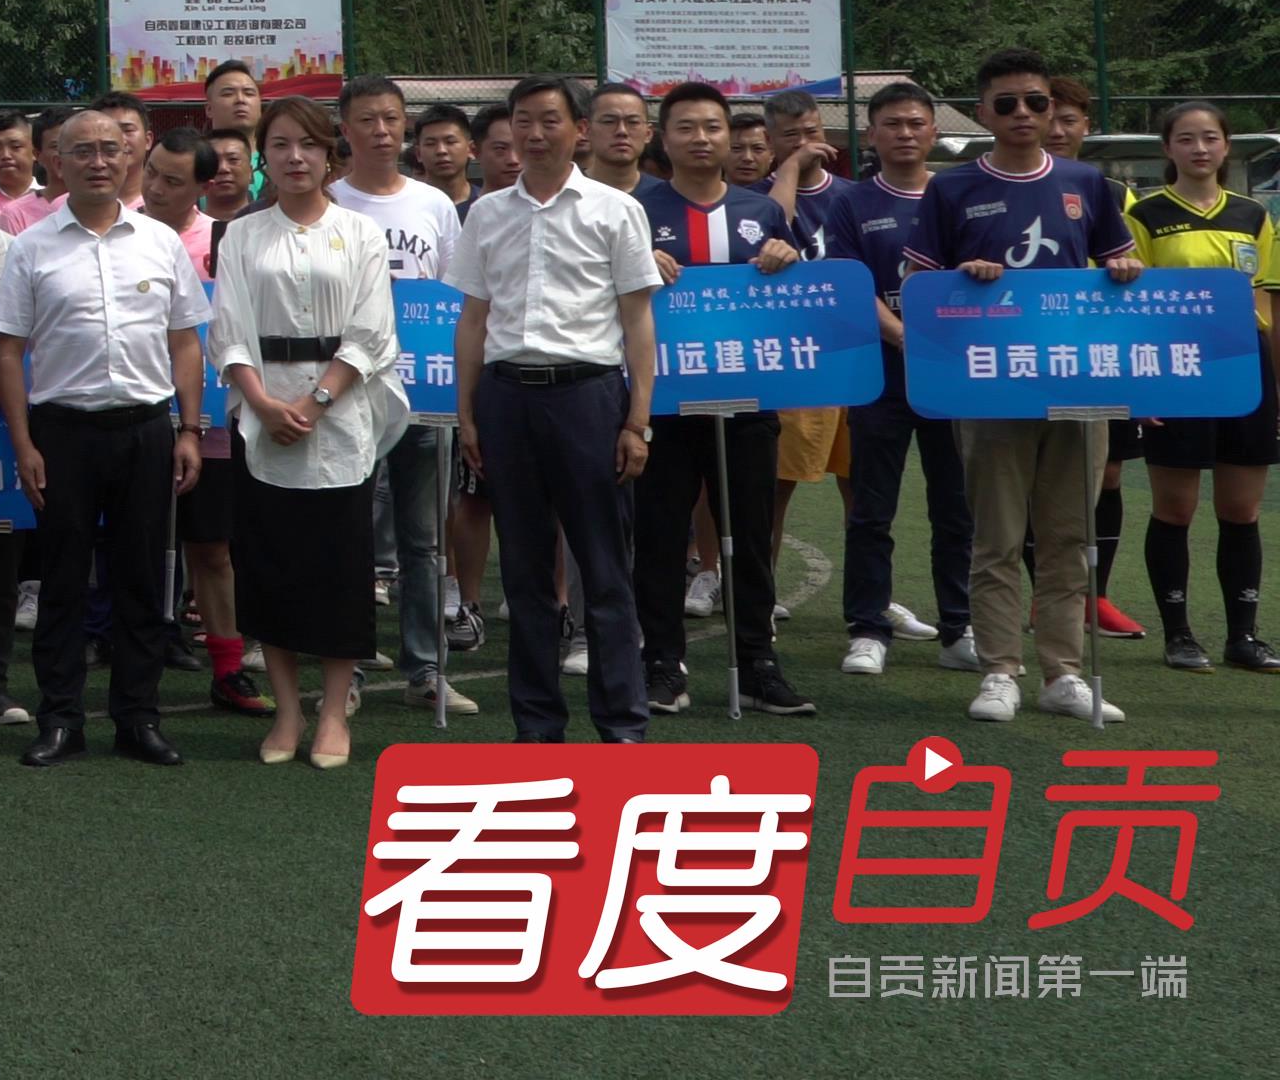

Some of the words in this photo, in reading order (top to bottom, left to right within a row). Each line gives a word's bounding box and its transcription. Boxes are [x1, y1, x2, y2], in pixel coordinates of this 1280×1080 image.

[144, 18, 307, 32] 自贡鑫磊建设工程咨询有限公司
[175, 35, 218, 46] 工程造价
[223, 34, 277, 45] 招投标代理
[668, 291, 696, 308] 2022
[1040, 293, 1070, 310] 2022
[402, 302, 430, 320] 2022
[965, 343, 1202, 379] 自贡市媒体联
